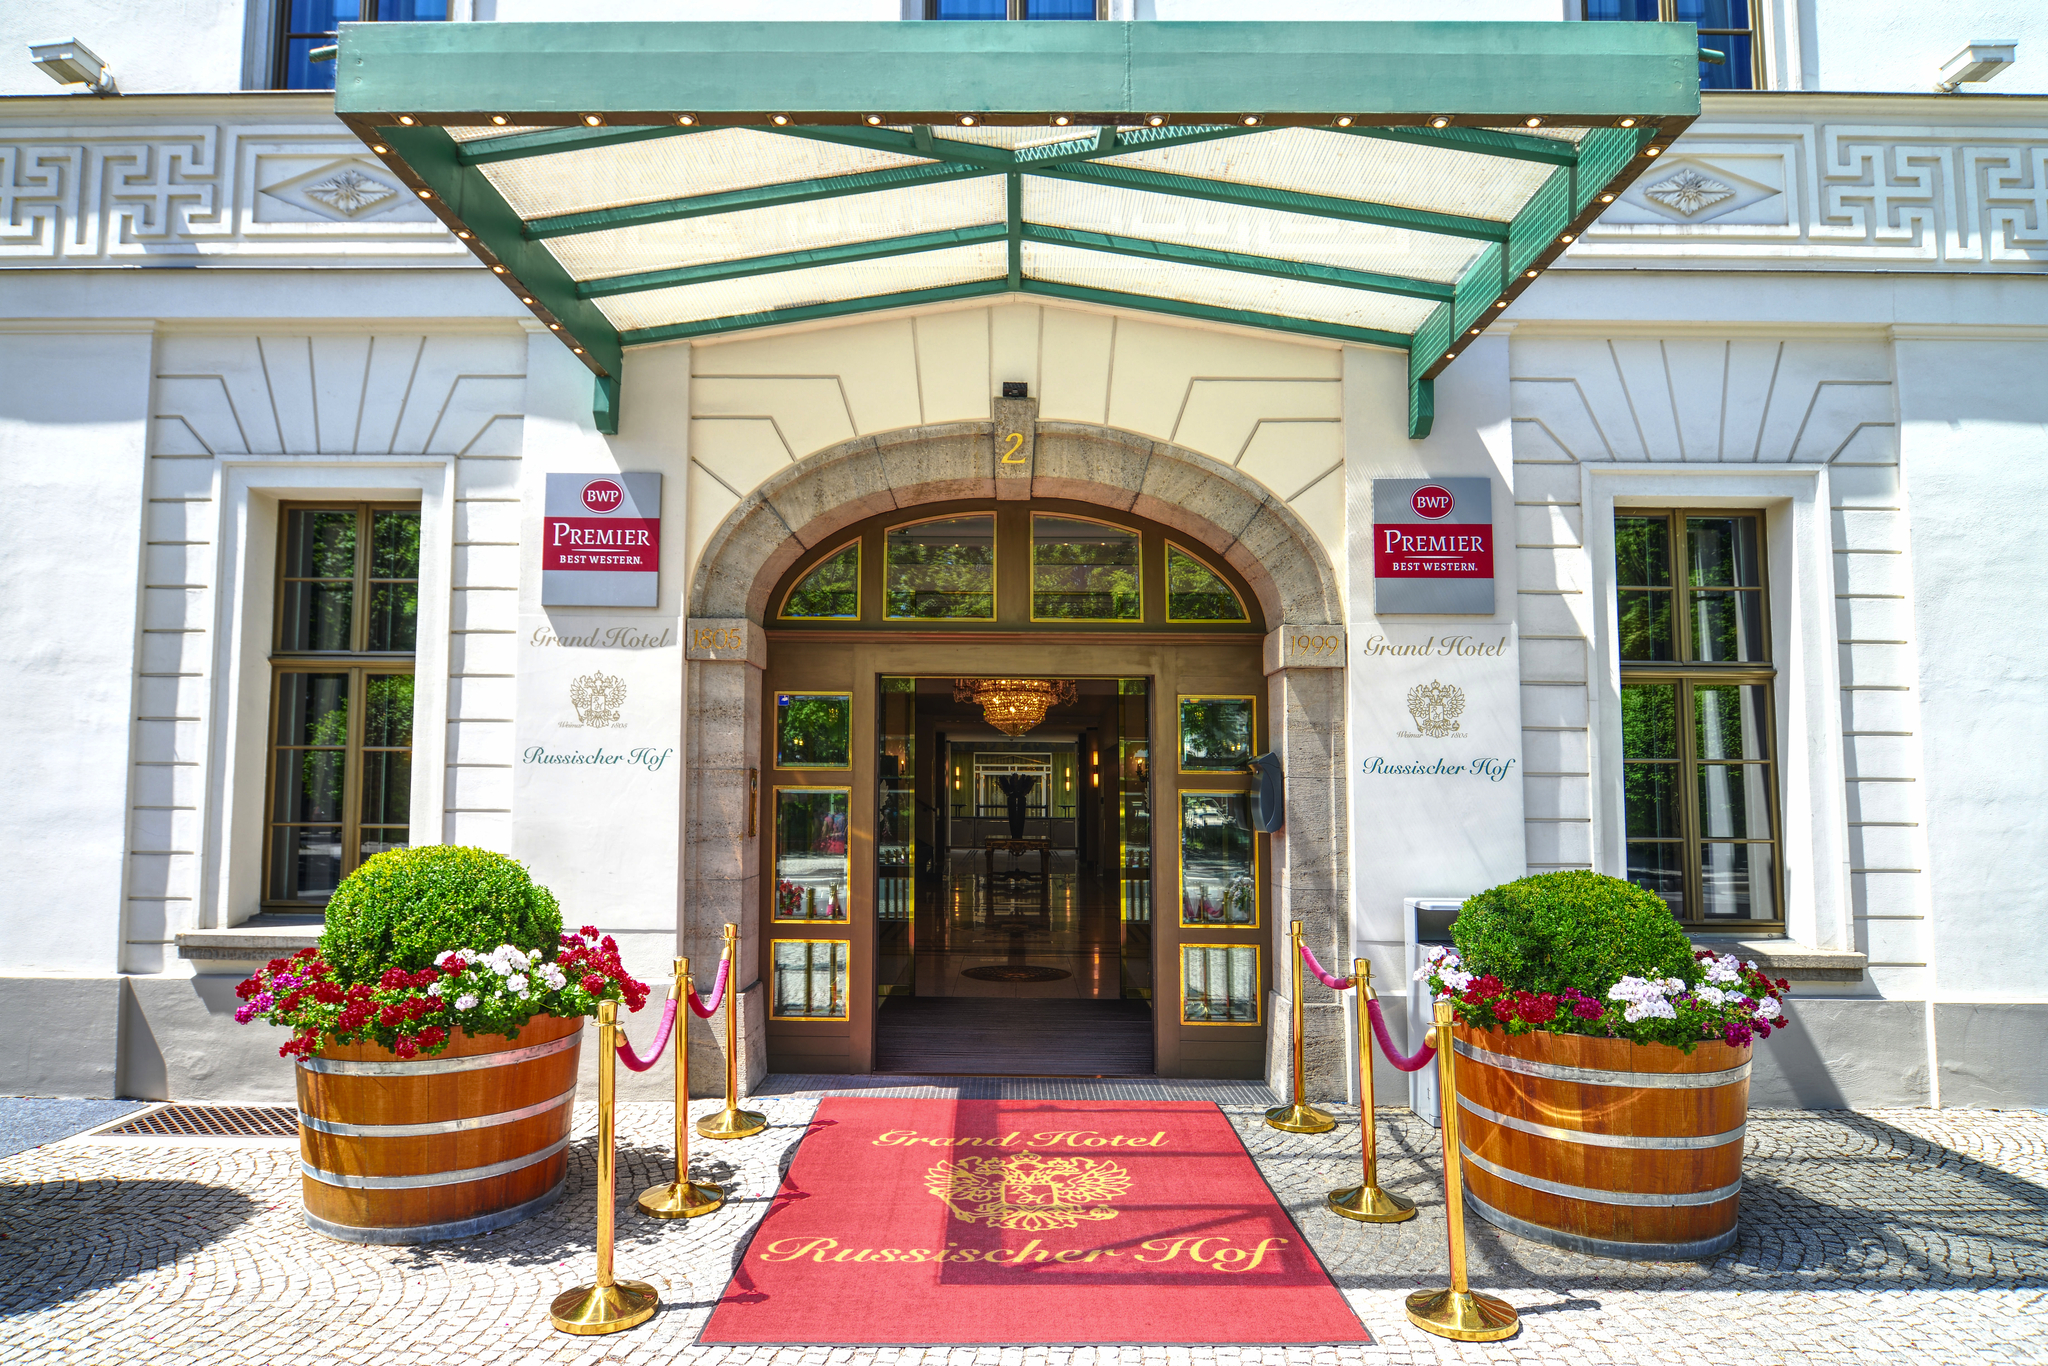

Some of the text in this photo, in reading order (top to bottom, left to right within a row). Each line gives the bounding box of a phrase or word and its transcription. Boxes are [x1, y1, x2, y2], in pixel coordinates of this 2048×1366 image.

[1001, 432, 1026, 464] 2
[586, 489, 619, 503] BWP
[1416, 496, 1449, 509] BWP
[552, 522, 651, 547] PREMIER
[1383, 529, 1485, 554] PREMIER
[559, 554, 587, 564] BEST
[1392, 562, 1421, 571] BEST
[530, 626, 670, 648] Grand Hotel
[691, 628, 742, 651] 1805
[1290, 635, 1339, 658] 1999
[1363, 634, 1507, 657] Grand Hotel
[522, 746, 673, 772] Russischer Hof
[1362, 755, 1516, 782] Russischer Hof
[871, 1129, 1170, 1149] Grand Hotel
[760, 1235, 1289, 1273] Russischer Hof
